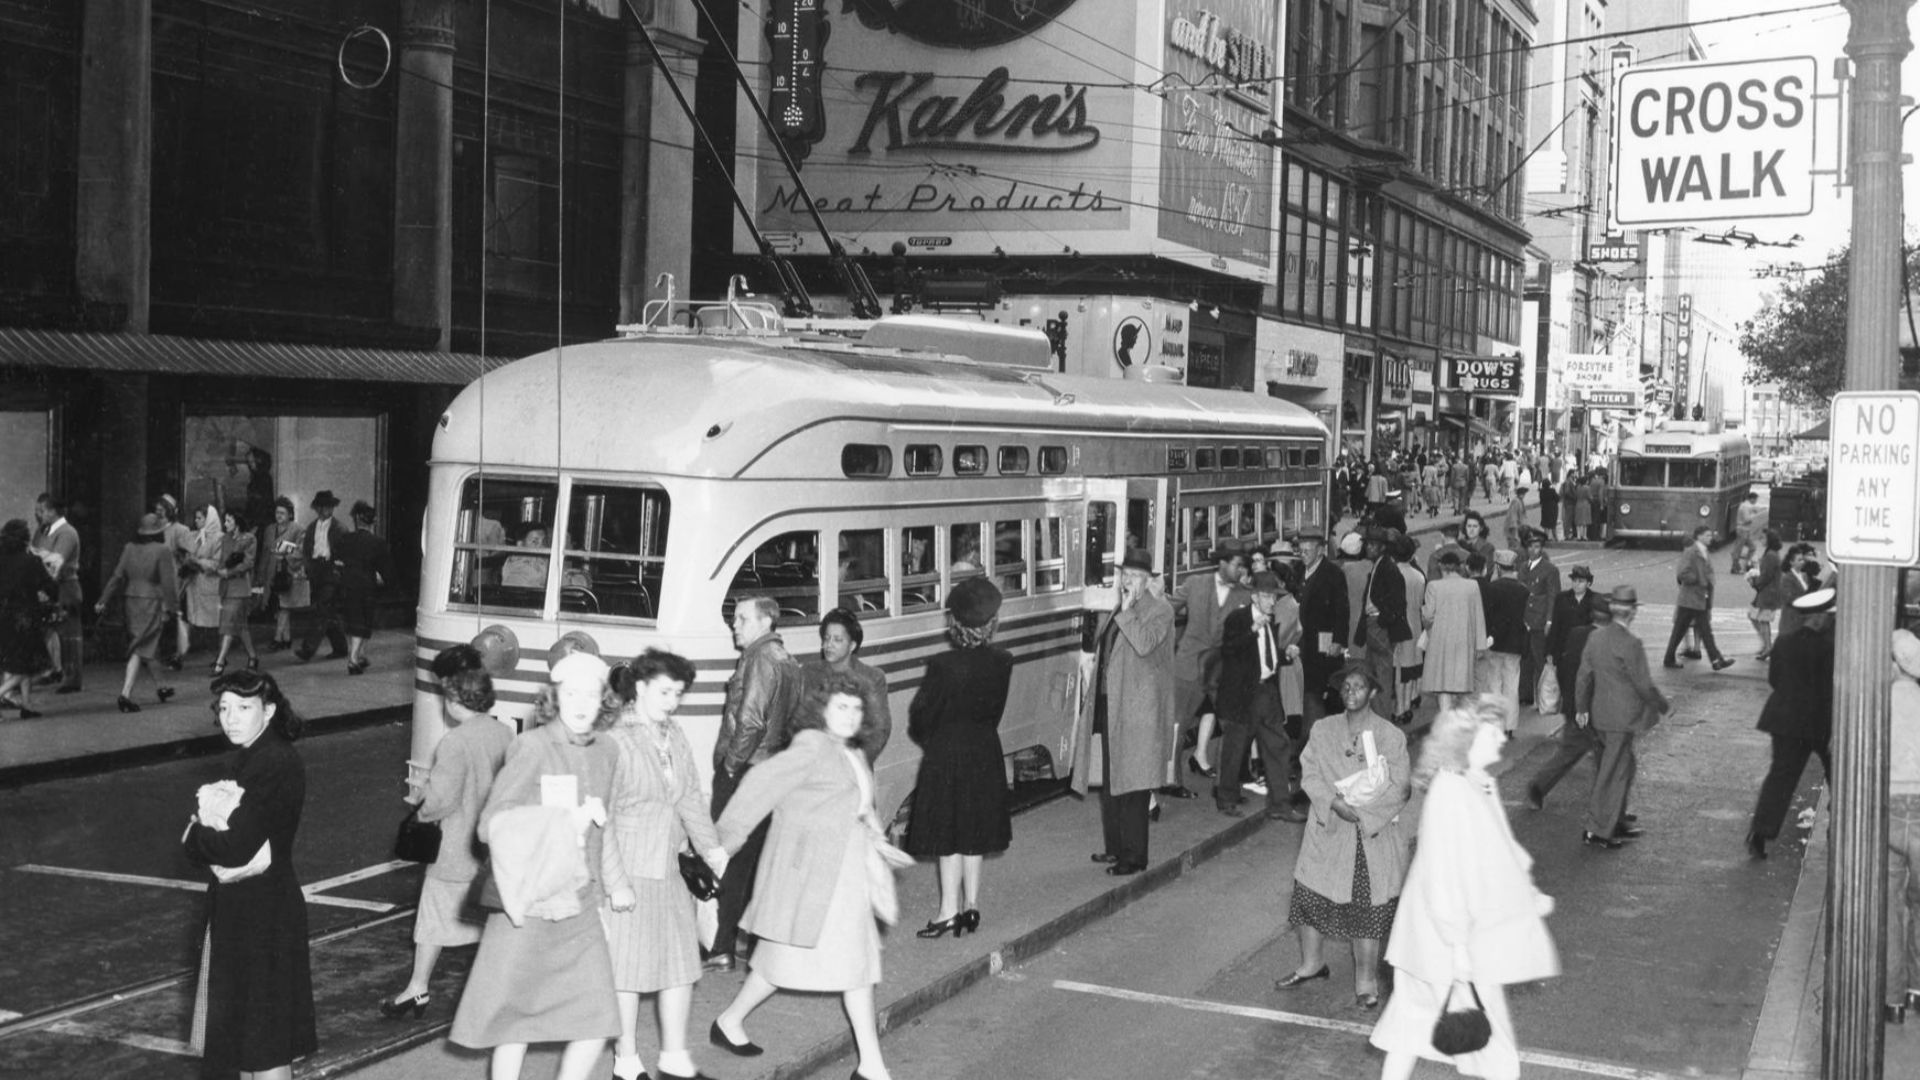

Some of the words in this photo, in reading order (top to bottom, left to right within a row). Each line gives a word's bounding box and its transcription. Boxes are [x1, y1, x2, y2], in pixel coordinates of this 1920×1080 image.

[777, 22, 787, 33] 10
[776, 75, 785, 87] 10
[848, 66, 1100, 153] Kahn's
[1630, 75, 1804, 138] CROSS
[1641, 149, 1787, 203] WALK
[763, 184, 883, 213] Meat
[906, 182, 1122, 213] Products
[1591, 247, 1639, 260] SHOES
[1679, 296, 1691, 336] HUB
[1456, 360, 1515, 377] DOW'S
[1566, 361, 1614, 373] FORSYTHE
[1585, 392, 1628, 403] OTTER'S
[1856, 404, 1896, 435] NO
[1840, 443, 1910, 466] PARKING
[1856, 477, 1891, 498] ANY
[1855, 506, 1891, 529] TIME
